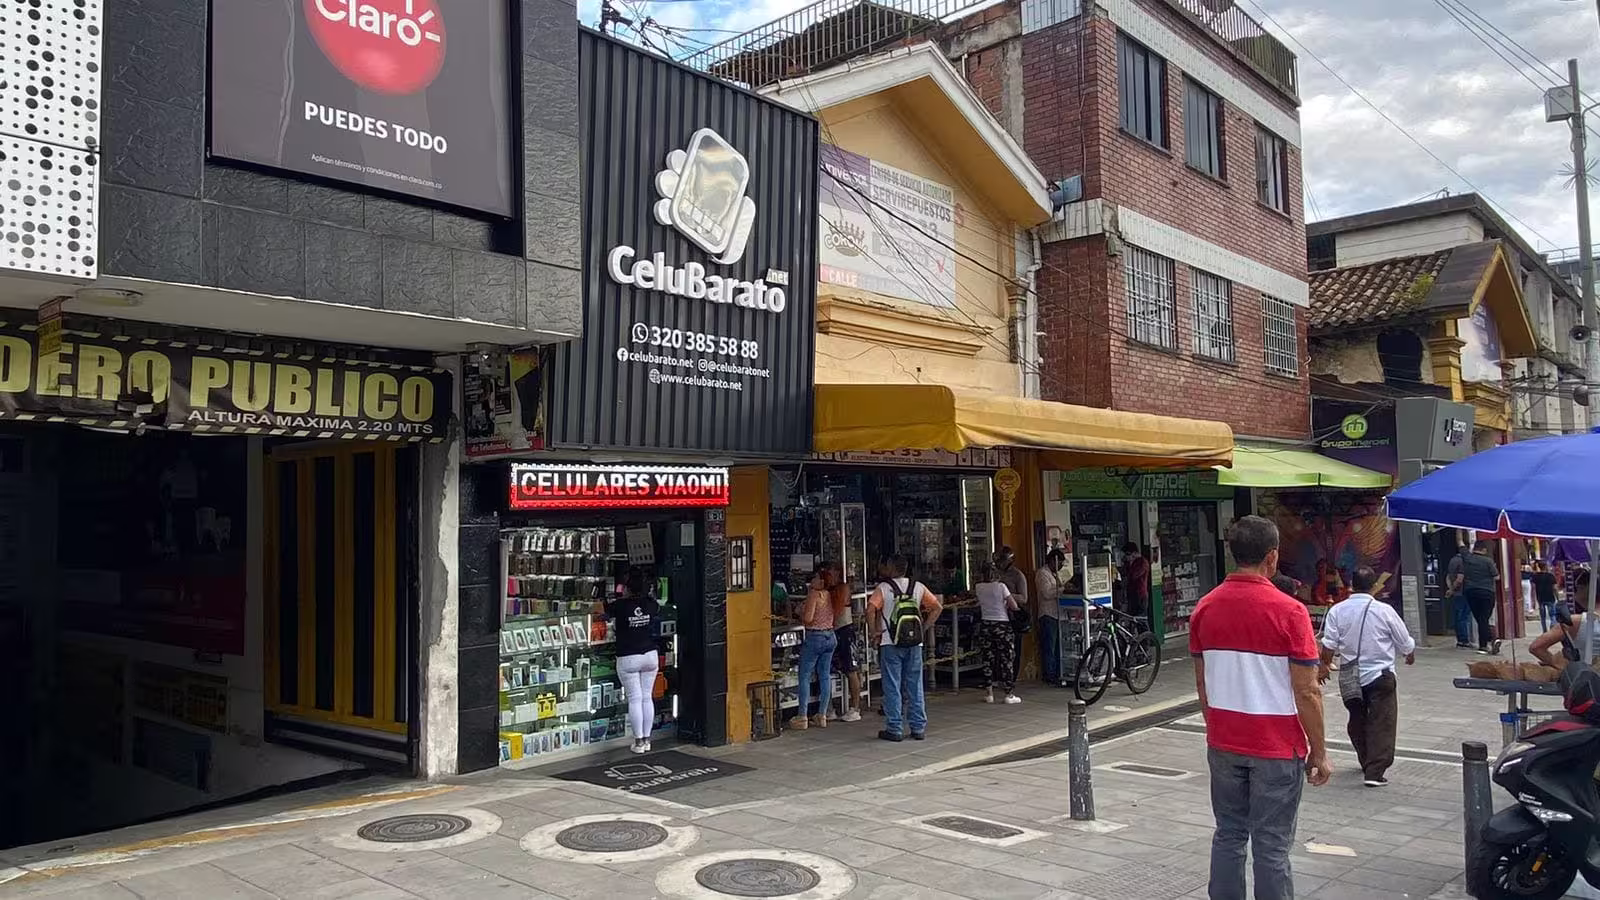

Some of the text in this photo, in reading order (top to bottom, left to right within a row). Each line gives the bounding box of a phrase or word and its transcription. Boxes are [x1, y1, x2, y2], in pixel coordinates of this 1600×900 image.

[314, 0, 421, 46] Claro
[304, 100, 448, 154] PUEDES TODO
[873, 184, 951, 222] SERVIREPUESTOS
[608, 245, 786, 313] CeluBarato
[829, 270, 857, 288] CALLE
[651, 325, 758, 359] 320 385 58 88
[629, 350, 770, 378] celubarato.net @celubaratonet
[190, 355, 433, 420] PUBLICO
[661, 374, 742, 391] www.celubarato.net
[188, 410, 433, 434] ALTURA MAXIMA 2.20 MTS
[521, 472, 721, 496] CELULARES XIAOMI
